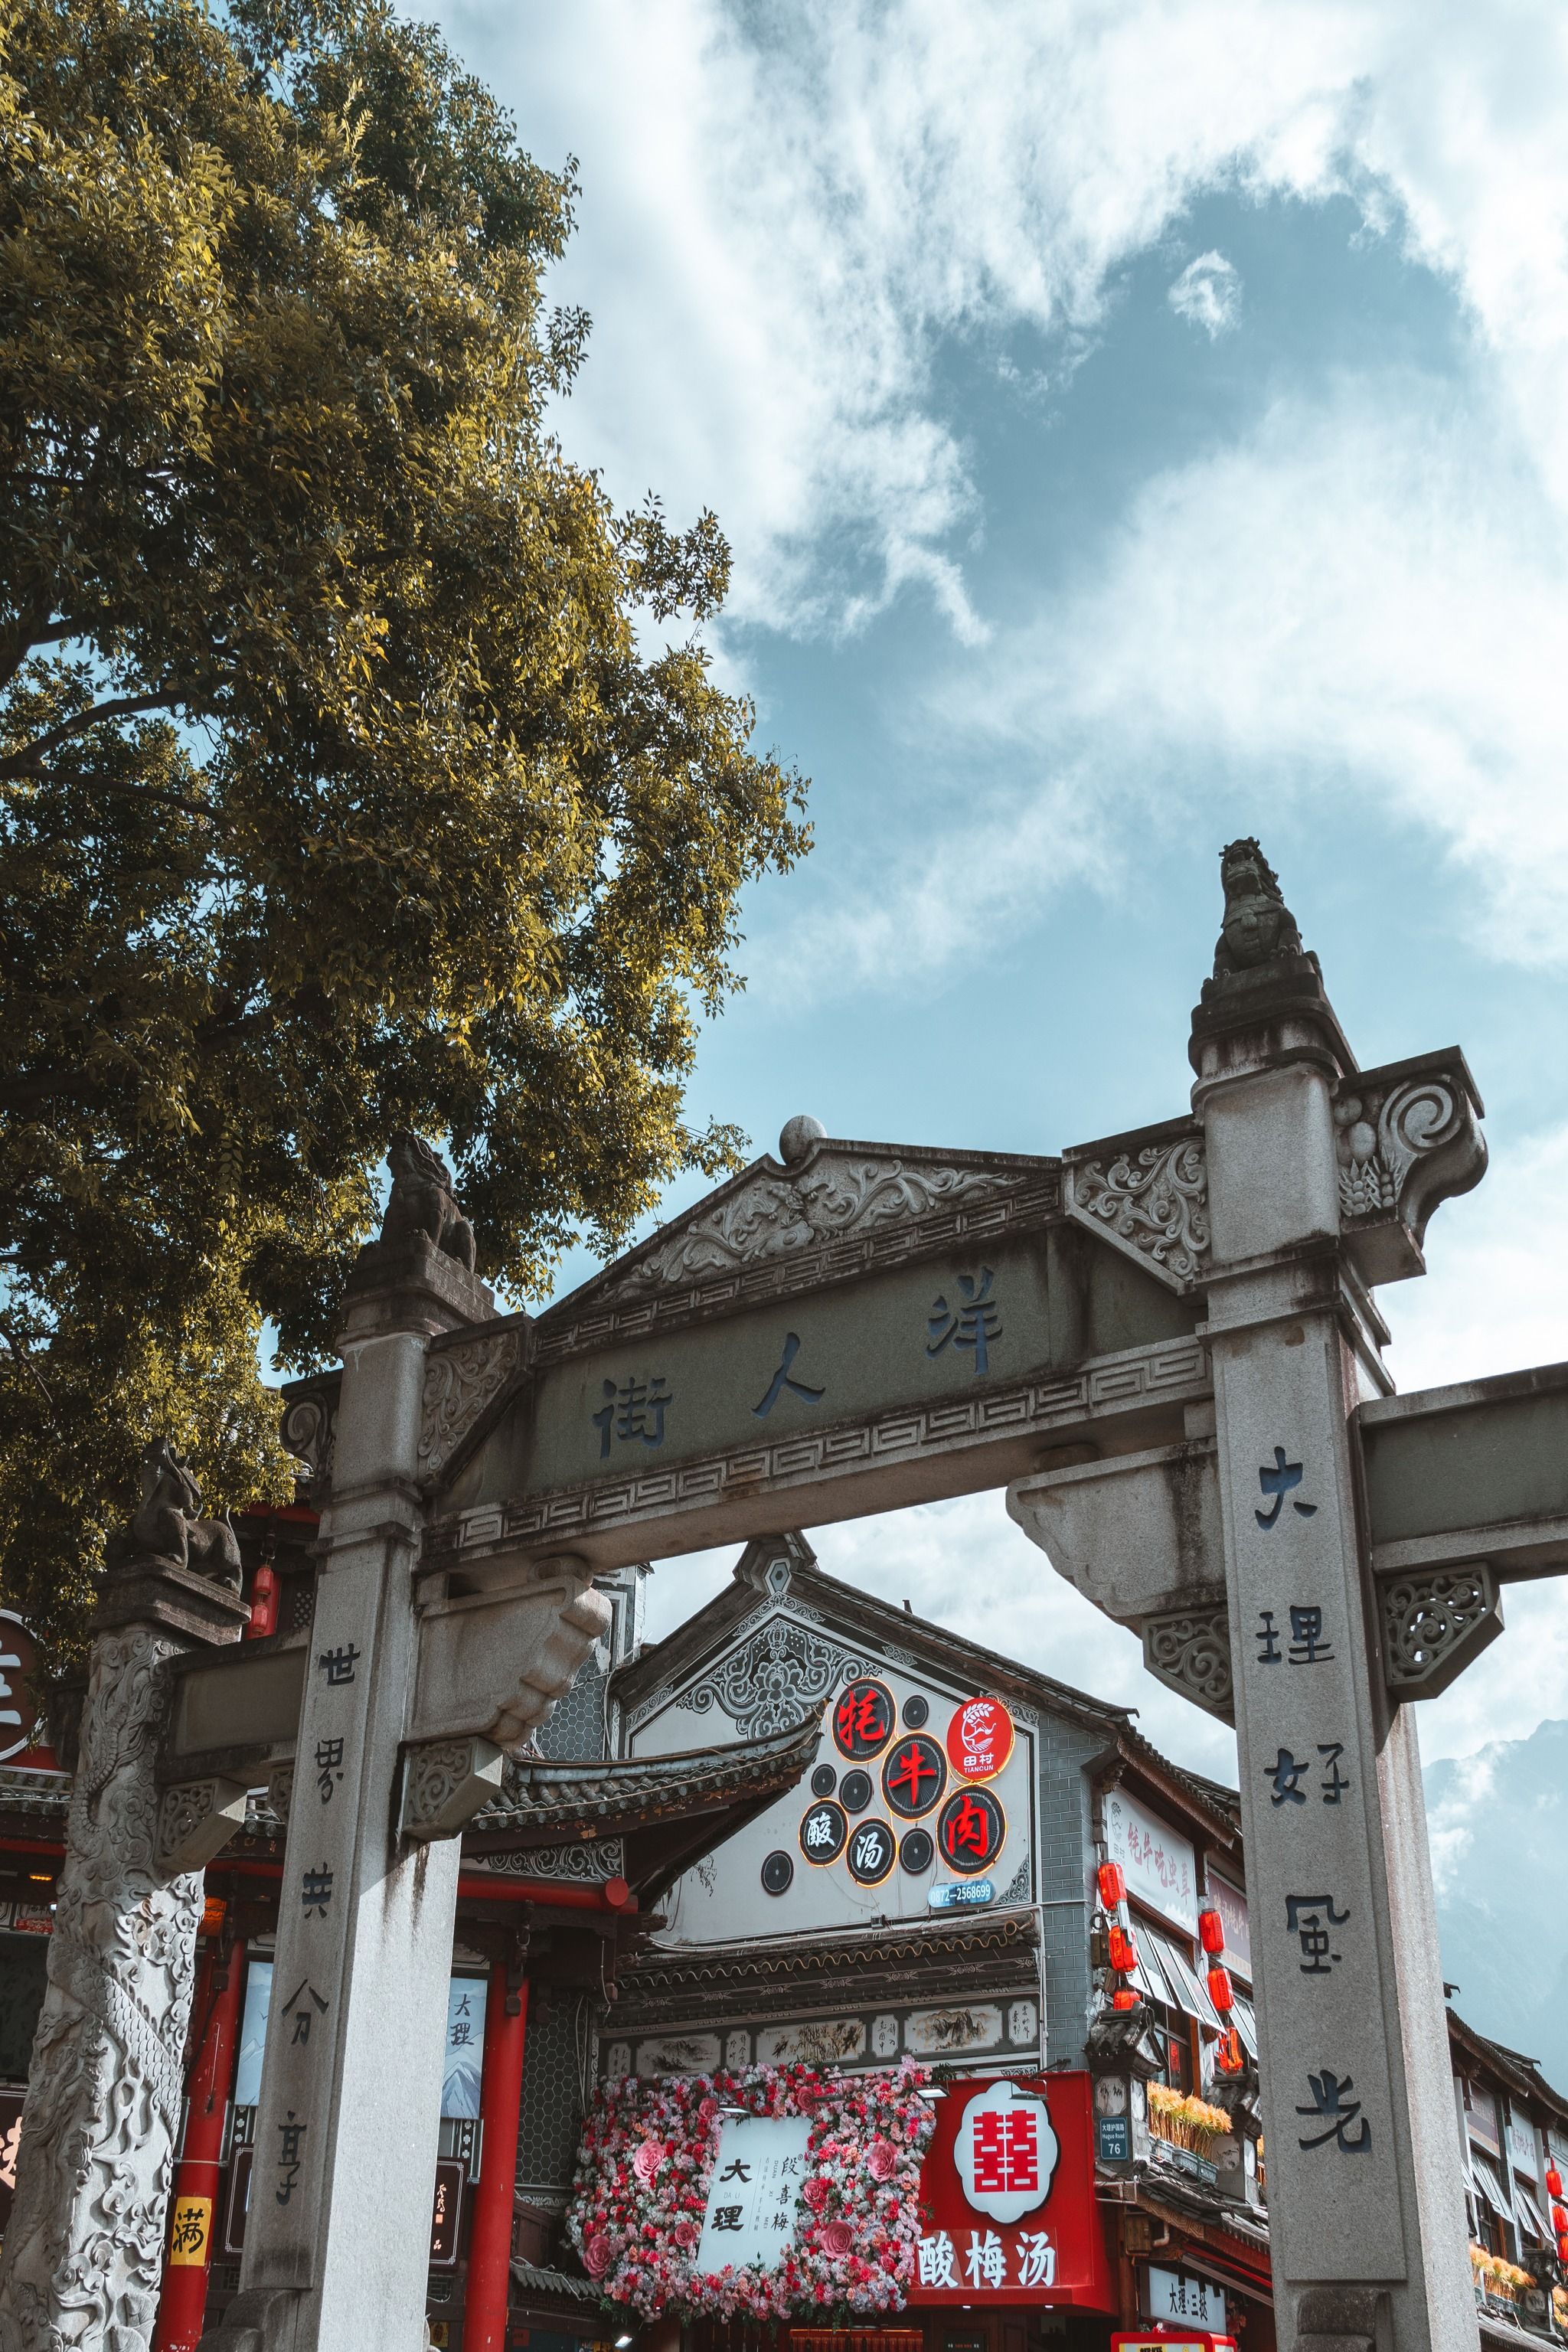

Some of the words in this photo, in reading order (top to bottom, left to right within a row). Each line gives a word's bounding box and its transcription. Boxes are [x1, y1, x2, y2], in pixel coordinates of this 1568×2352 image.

[838, 1689, 990, 1859] 牦牛肉
[963, 1753, 994, 1766] 田村
[964, 1765, 994, 1774] TIANCUN
[807, 1811, 882, 1870] 酸汤
[449, 1994, 475, 2047] 大理
[1102, 2123, 1125, 2132] 大理护国路
[1108, 2143, 1121, 2154] 76
[172, 2207, 204, 2254] 满
[916, 2229, 1057, 2289] 酸梅汤
